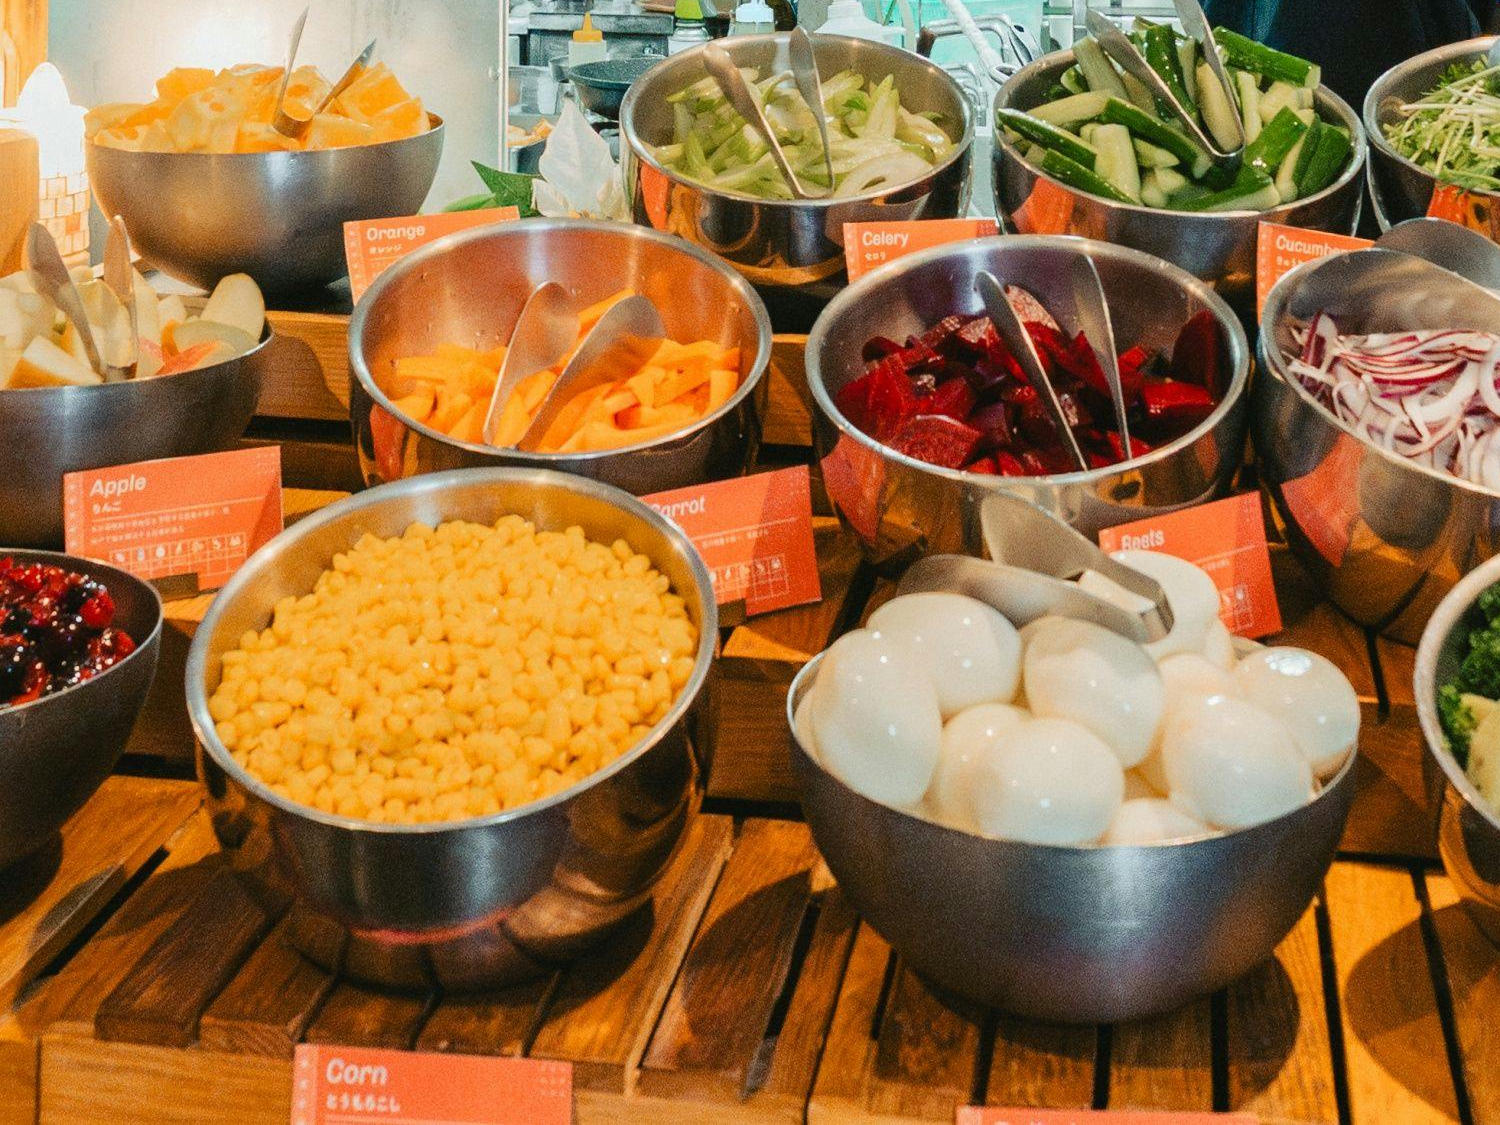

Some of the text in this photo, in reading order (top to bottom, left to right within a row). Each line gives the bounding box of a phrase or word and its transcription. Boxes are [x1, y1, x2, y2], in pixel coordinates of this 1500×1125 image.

[367, 225, 426, 242] Orange
[862, 231, 910, 248] Celery
[90, 474, 148, 499] Apple
[326, 1058, 389, 1086] Corn
